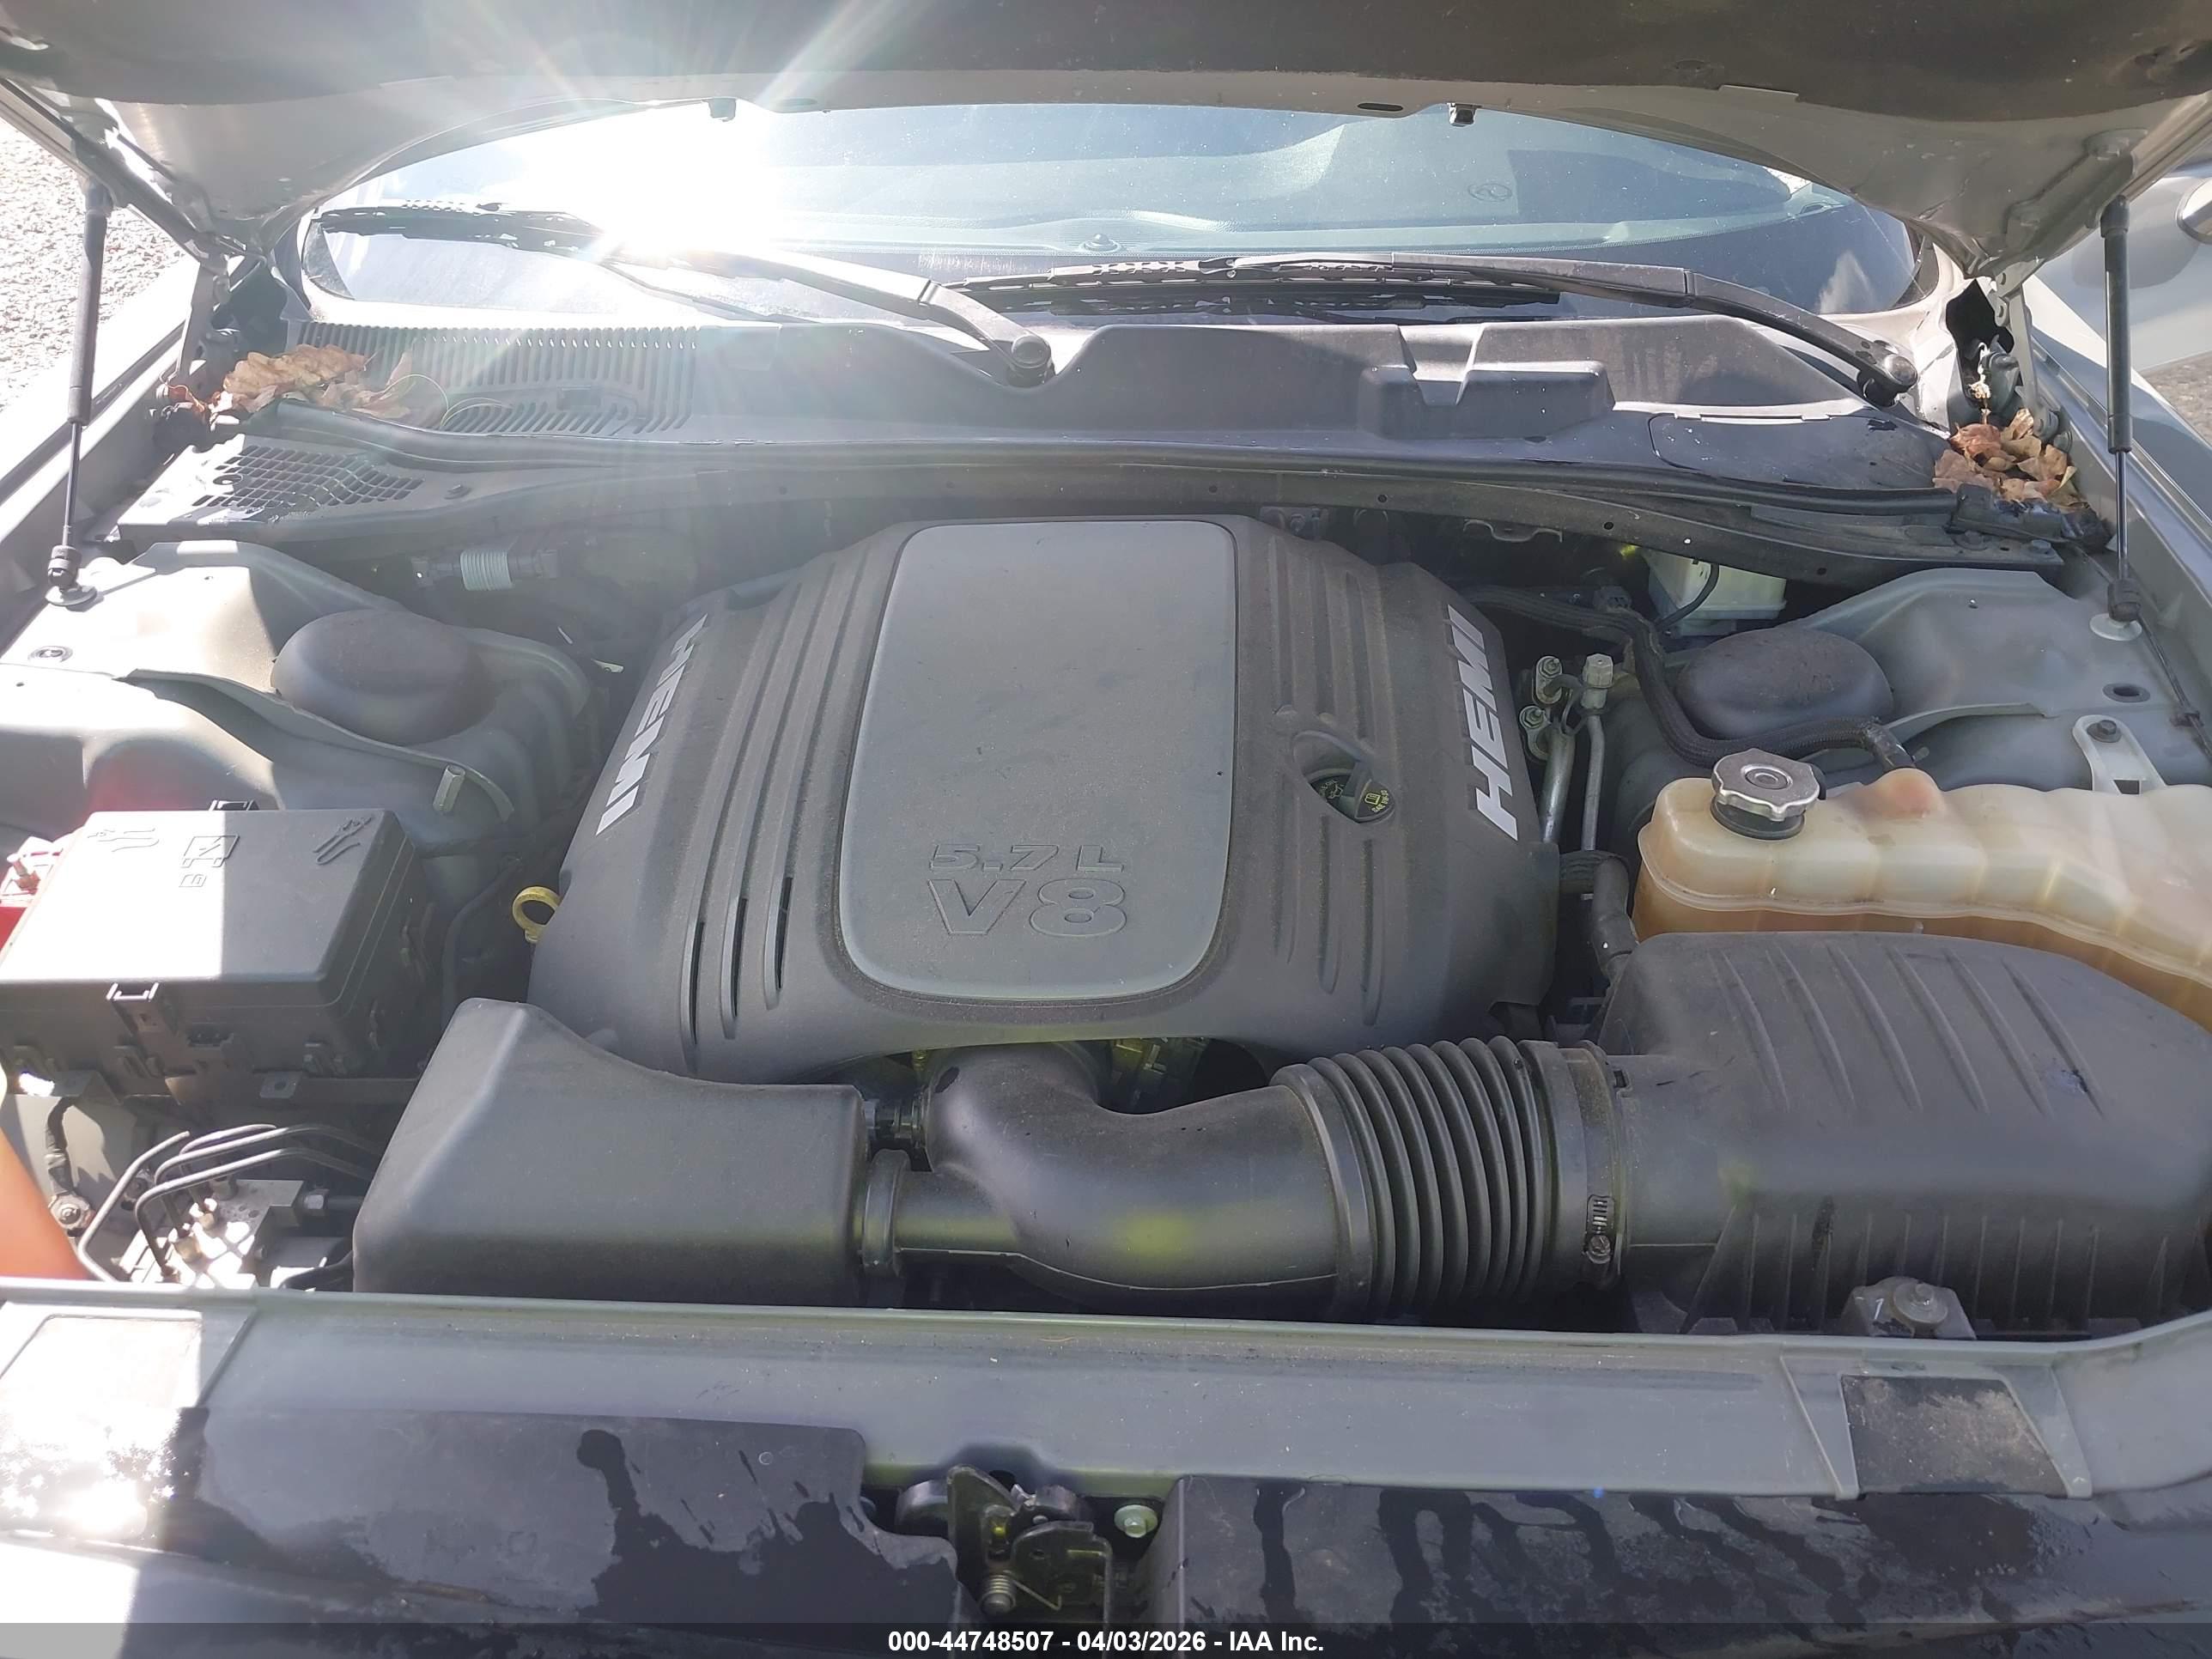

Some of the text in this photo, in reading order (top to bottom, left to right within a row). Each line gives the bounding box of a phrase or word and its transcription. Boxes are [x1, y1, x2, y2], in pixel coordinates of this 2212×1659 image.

[596, 613, 708, 836] HEMI
[1448, 604, 1518, 842] HEMI
[927, 878, 1127, 939] V8
